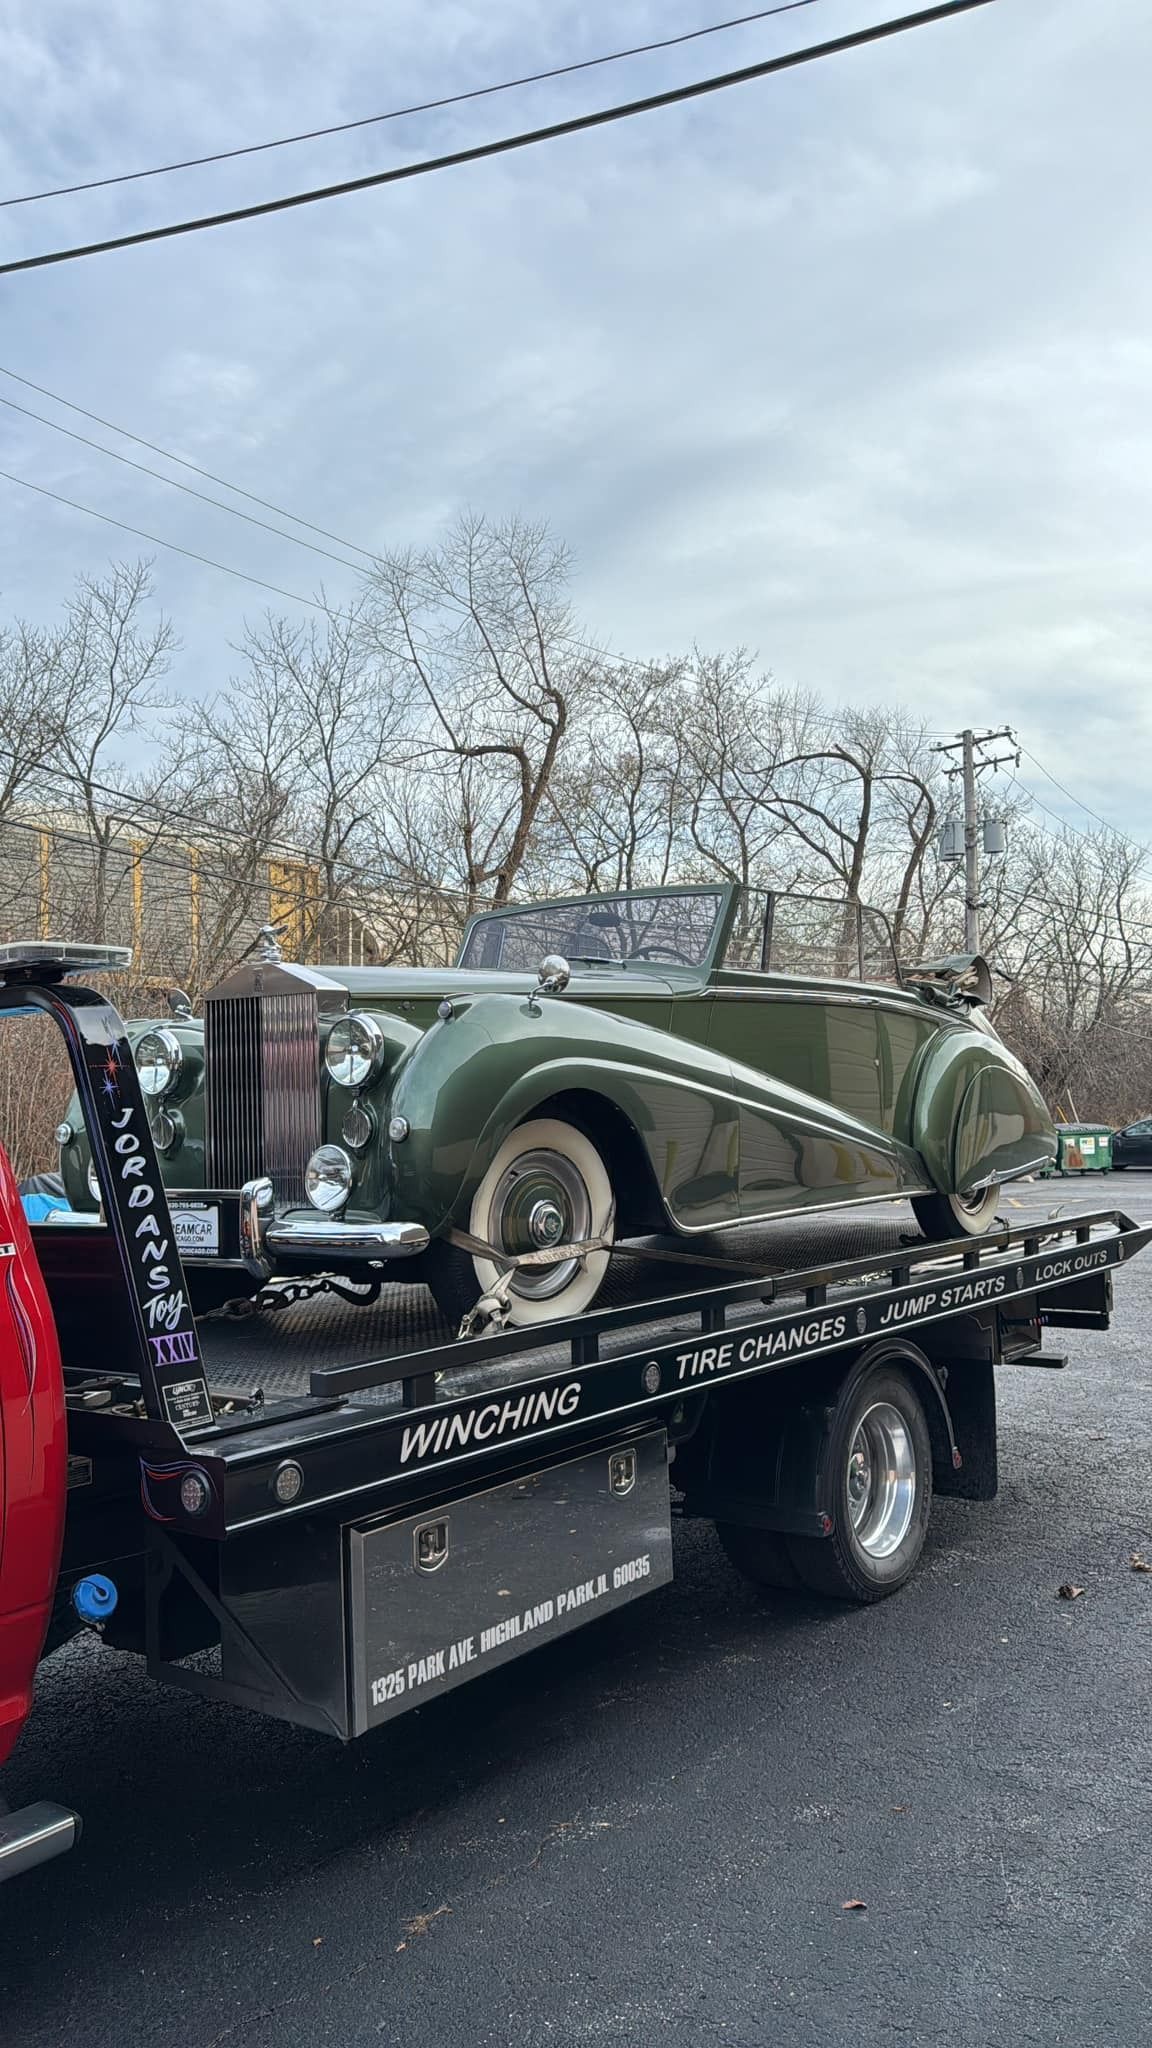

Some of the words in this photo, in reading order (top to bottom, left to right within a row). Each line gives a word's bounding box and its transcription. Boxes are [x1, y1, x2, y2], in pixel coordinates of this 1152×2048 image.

[111, 1107, 171, 1290] JORDANS
[172, 1223, 213, 1235] EAMCAR
[1036, 1260, 1071, 1281] LOCK
[1074, 1250, 1108, 1268] OUTS
[880, 1293, 936, 1325] JUMP
[939, 1275, 1006, 1308] STARTS
[148, 1331, 198, 1367] XXIV
[675, 1343, 734, 1380] TIRE
[739, 1315, 847, 1363] CHANGES
[399, 1382, 582, 1464] WINCHING
[370, 1668, 406, 1707] 1325
[407, 1650, 446, 1690] PARK
[448, 1636, 478, 1671] AVE.
[480, 1599, 554, 1654] HIGHLAND
[613, 1553, 651, 1591] 60035
